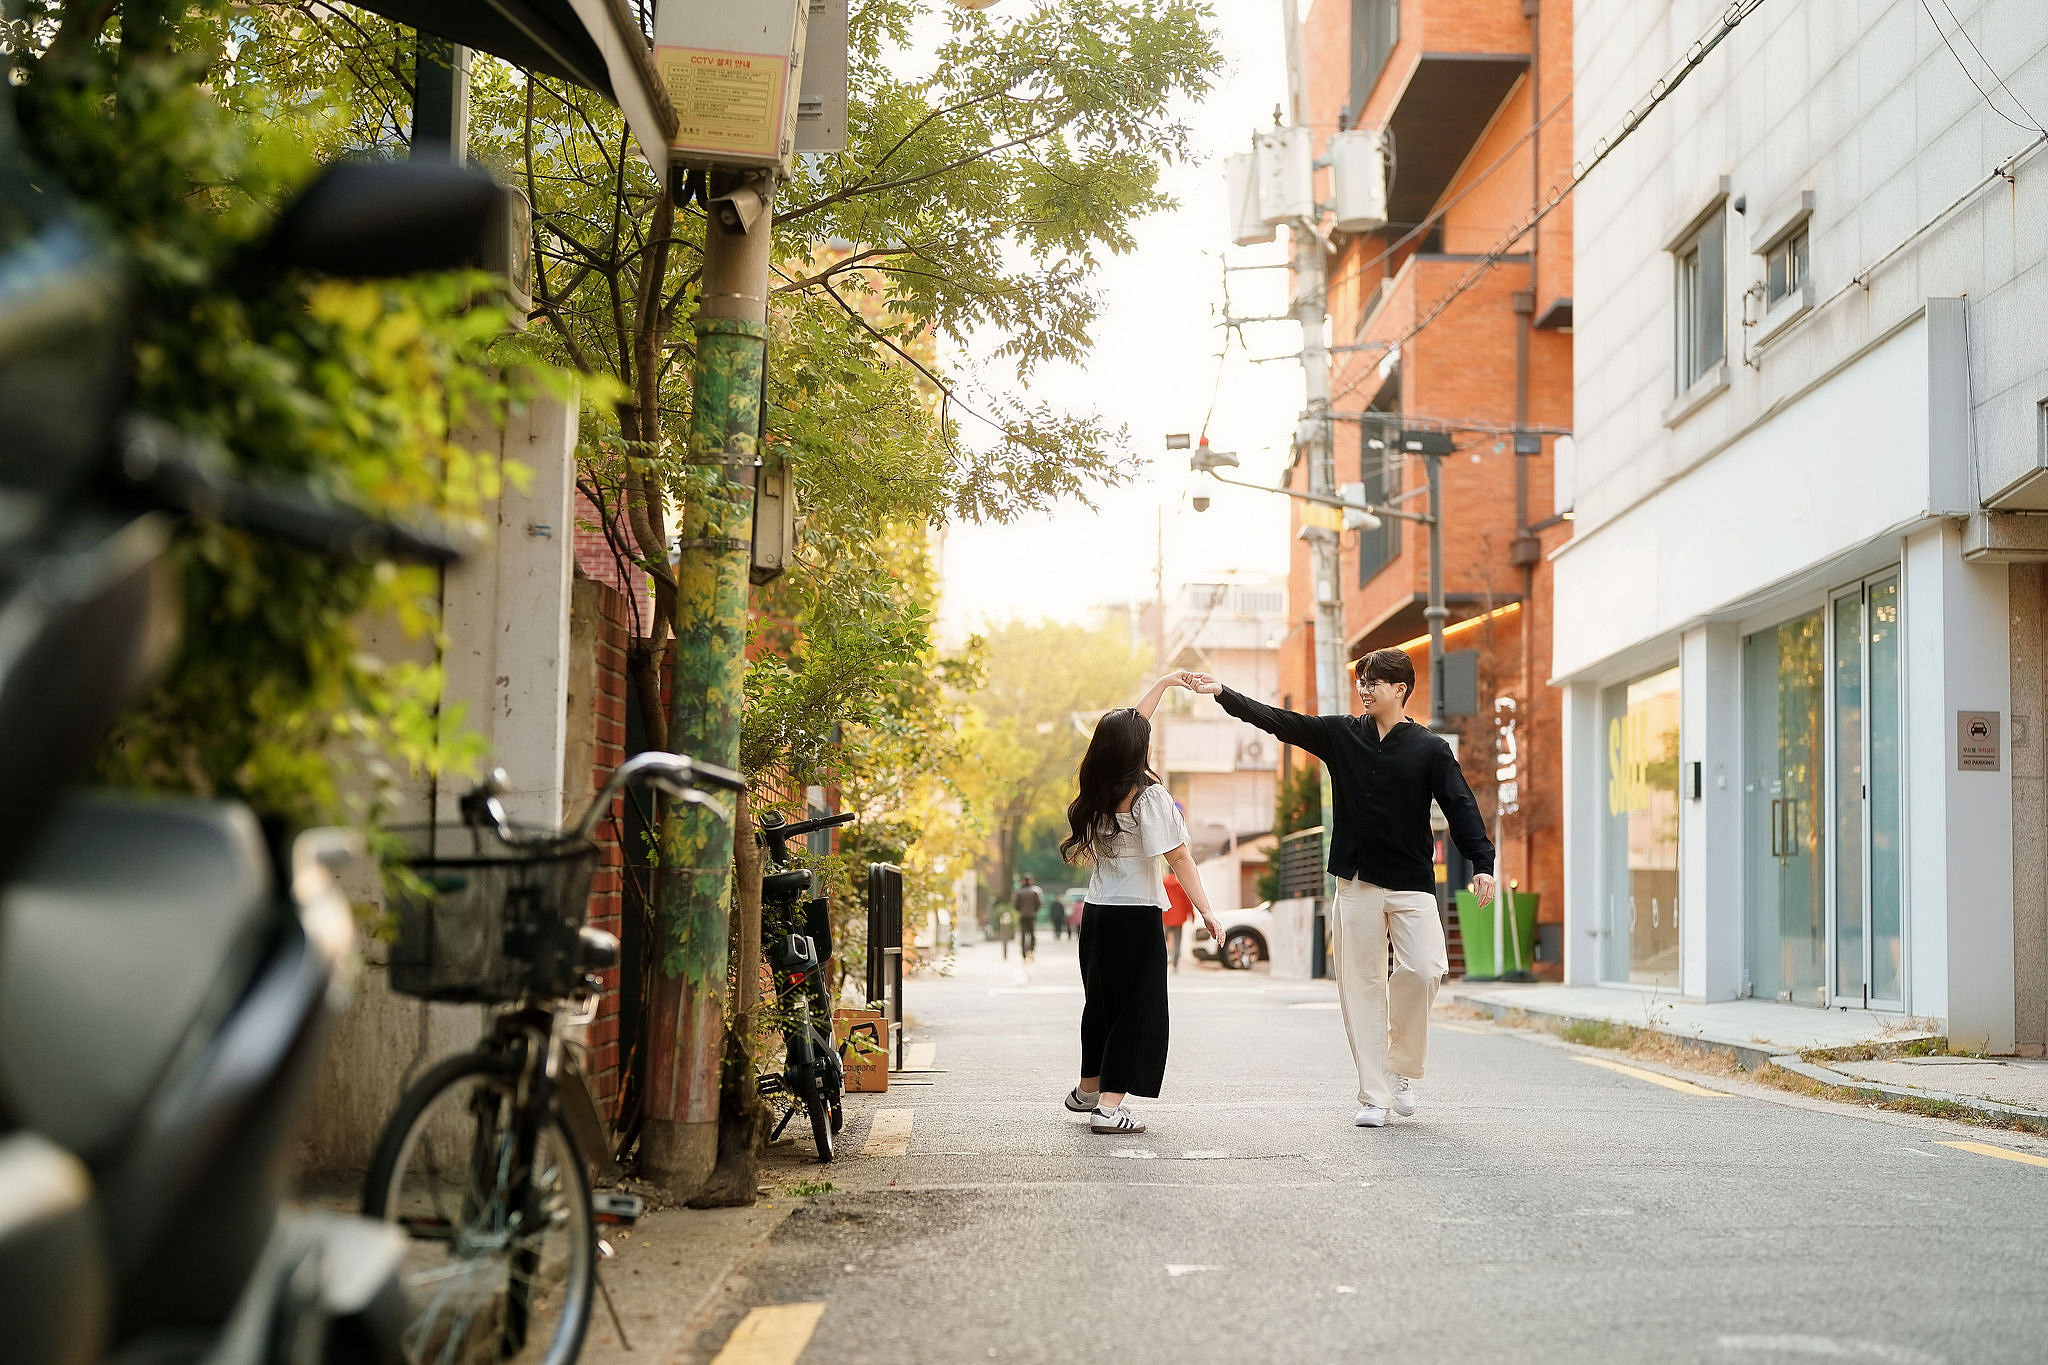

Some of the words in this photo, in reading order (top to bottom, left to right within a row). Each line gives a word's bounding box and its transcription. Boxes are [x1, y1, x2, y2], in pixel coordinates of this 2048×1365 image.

[690, 56, 714, 65] CCTV
[716, 57, 732, 67] 설치
[734, 59, 751, 68] 안내
